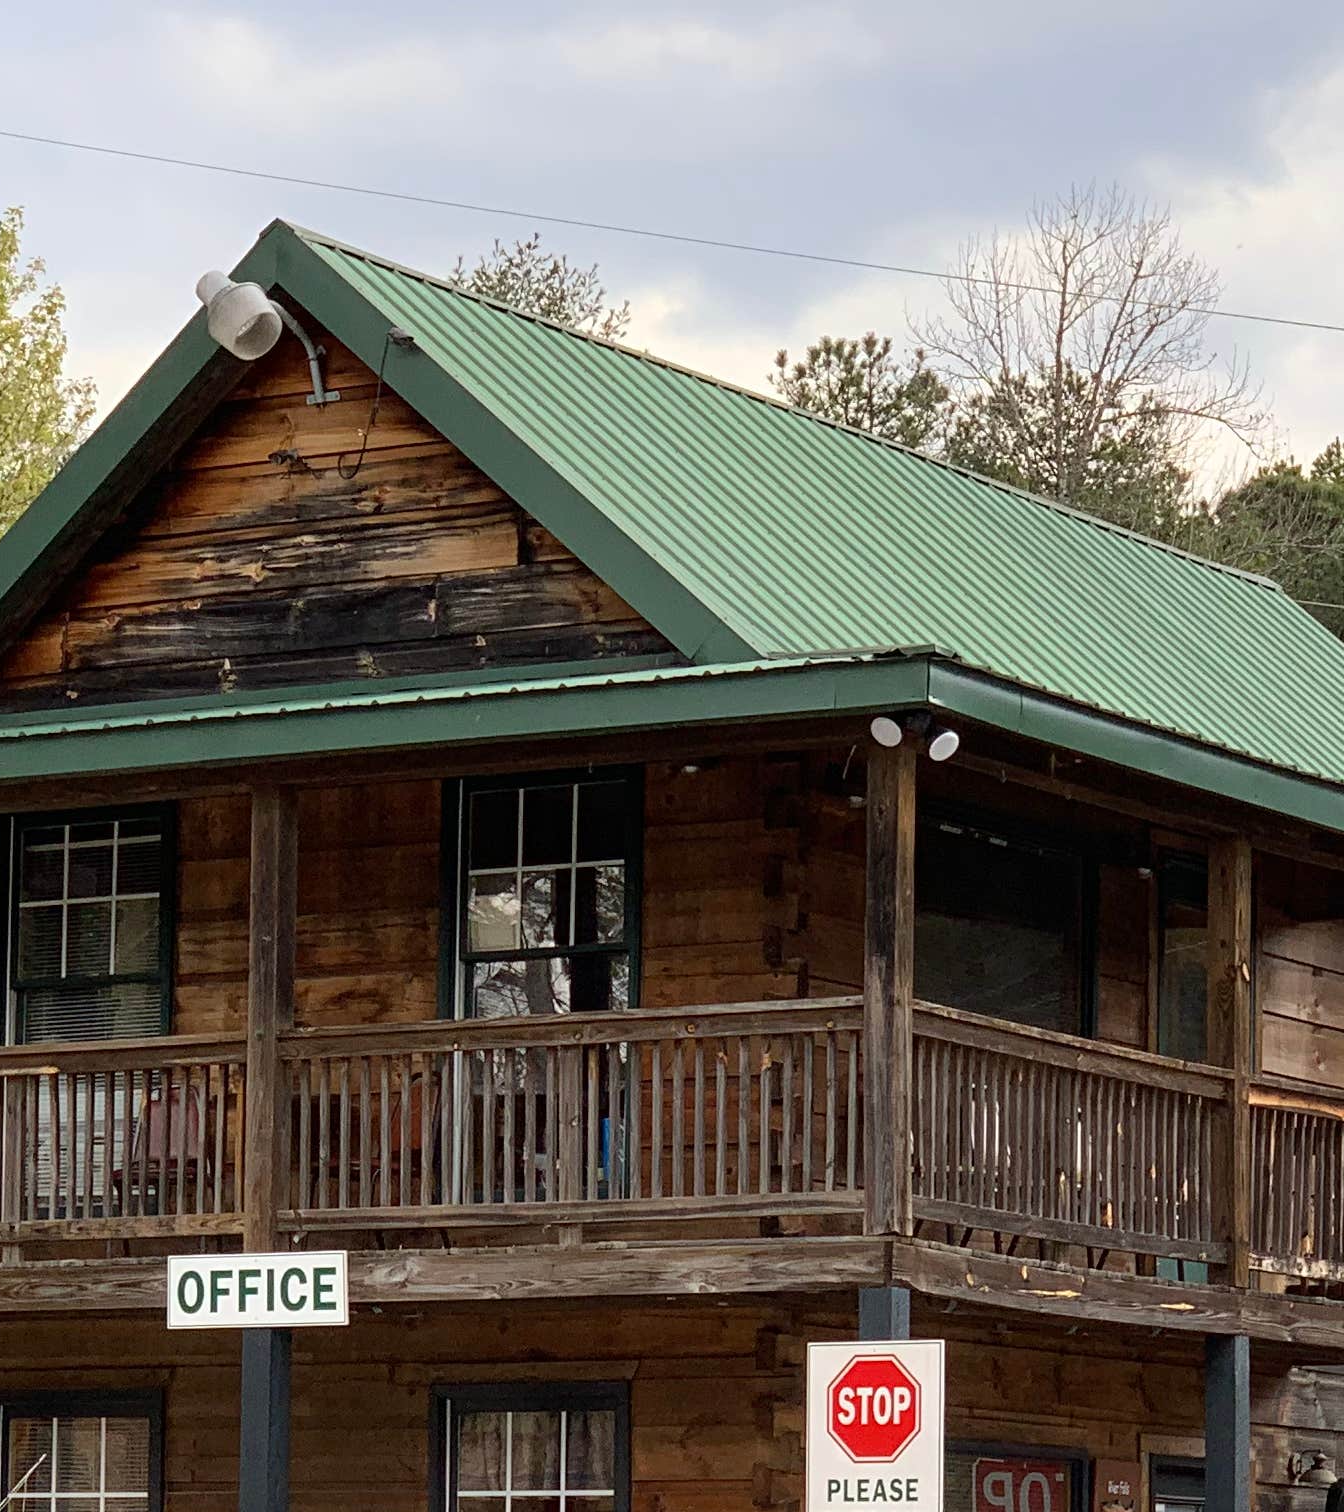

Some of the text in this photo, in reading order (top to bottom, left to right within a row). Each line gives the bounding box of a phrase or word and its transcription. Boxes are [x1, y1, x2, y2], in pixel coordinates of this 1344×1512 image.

[177, 1266, 337, 1314] OFFICE
[837, 1386, 911, 1426] STOP
[827, 1478, 919, 1502] PLEASE
